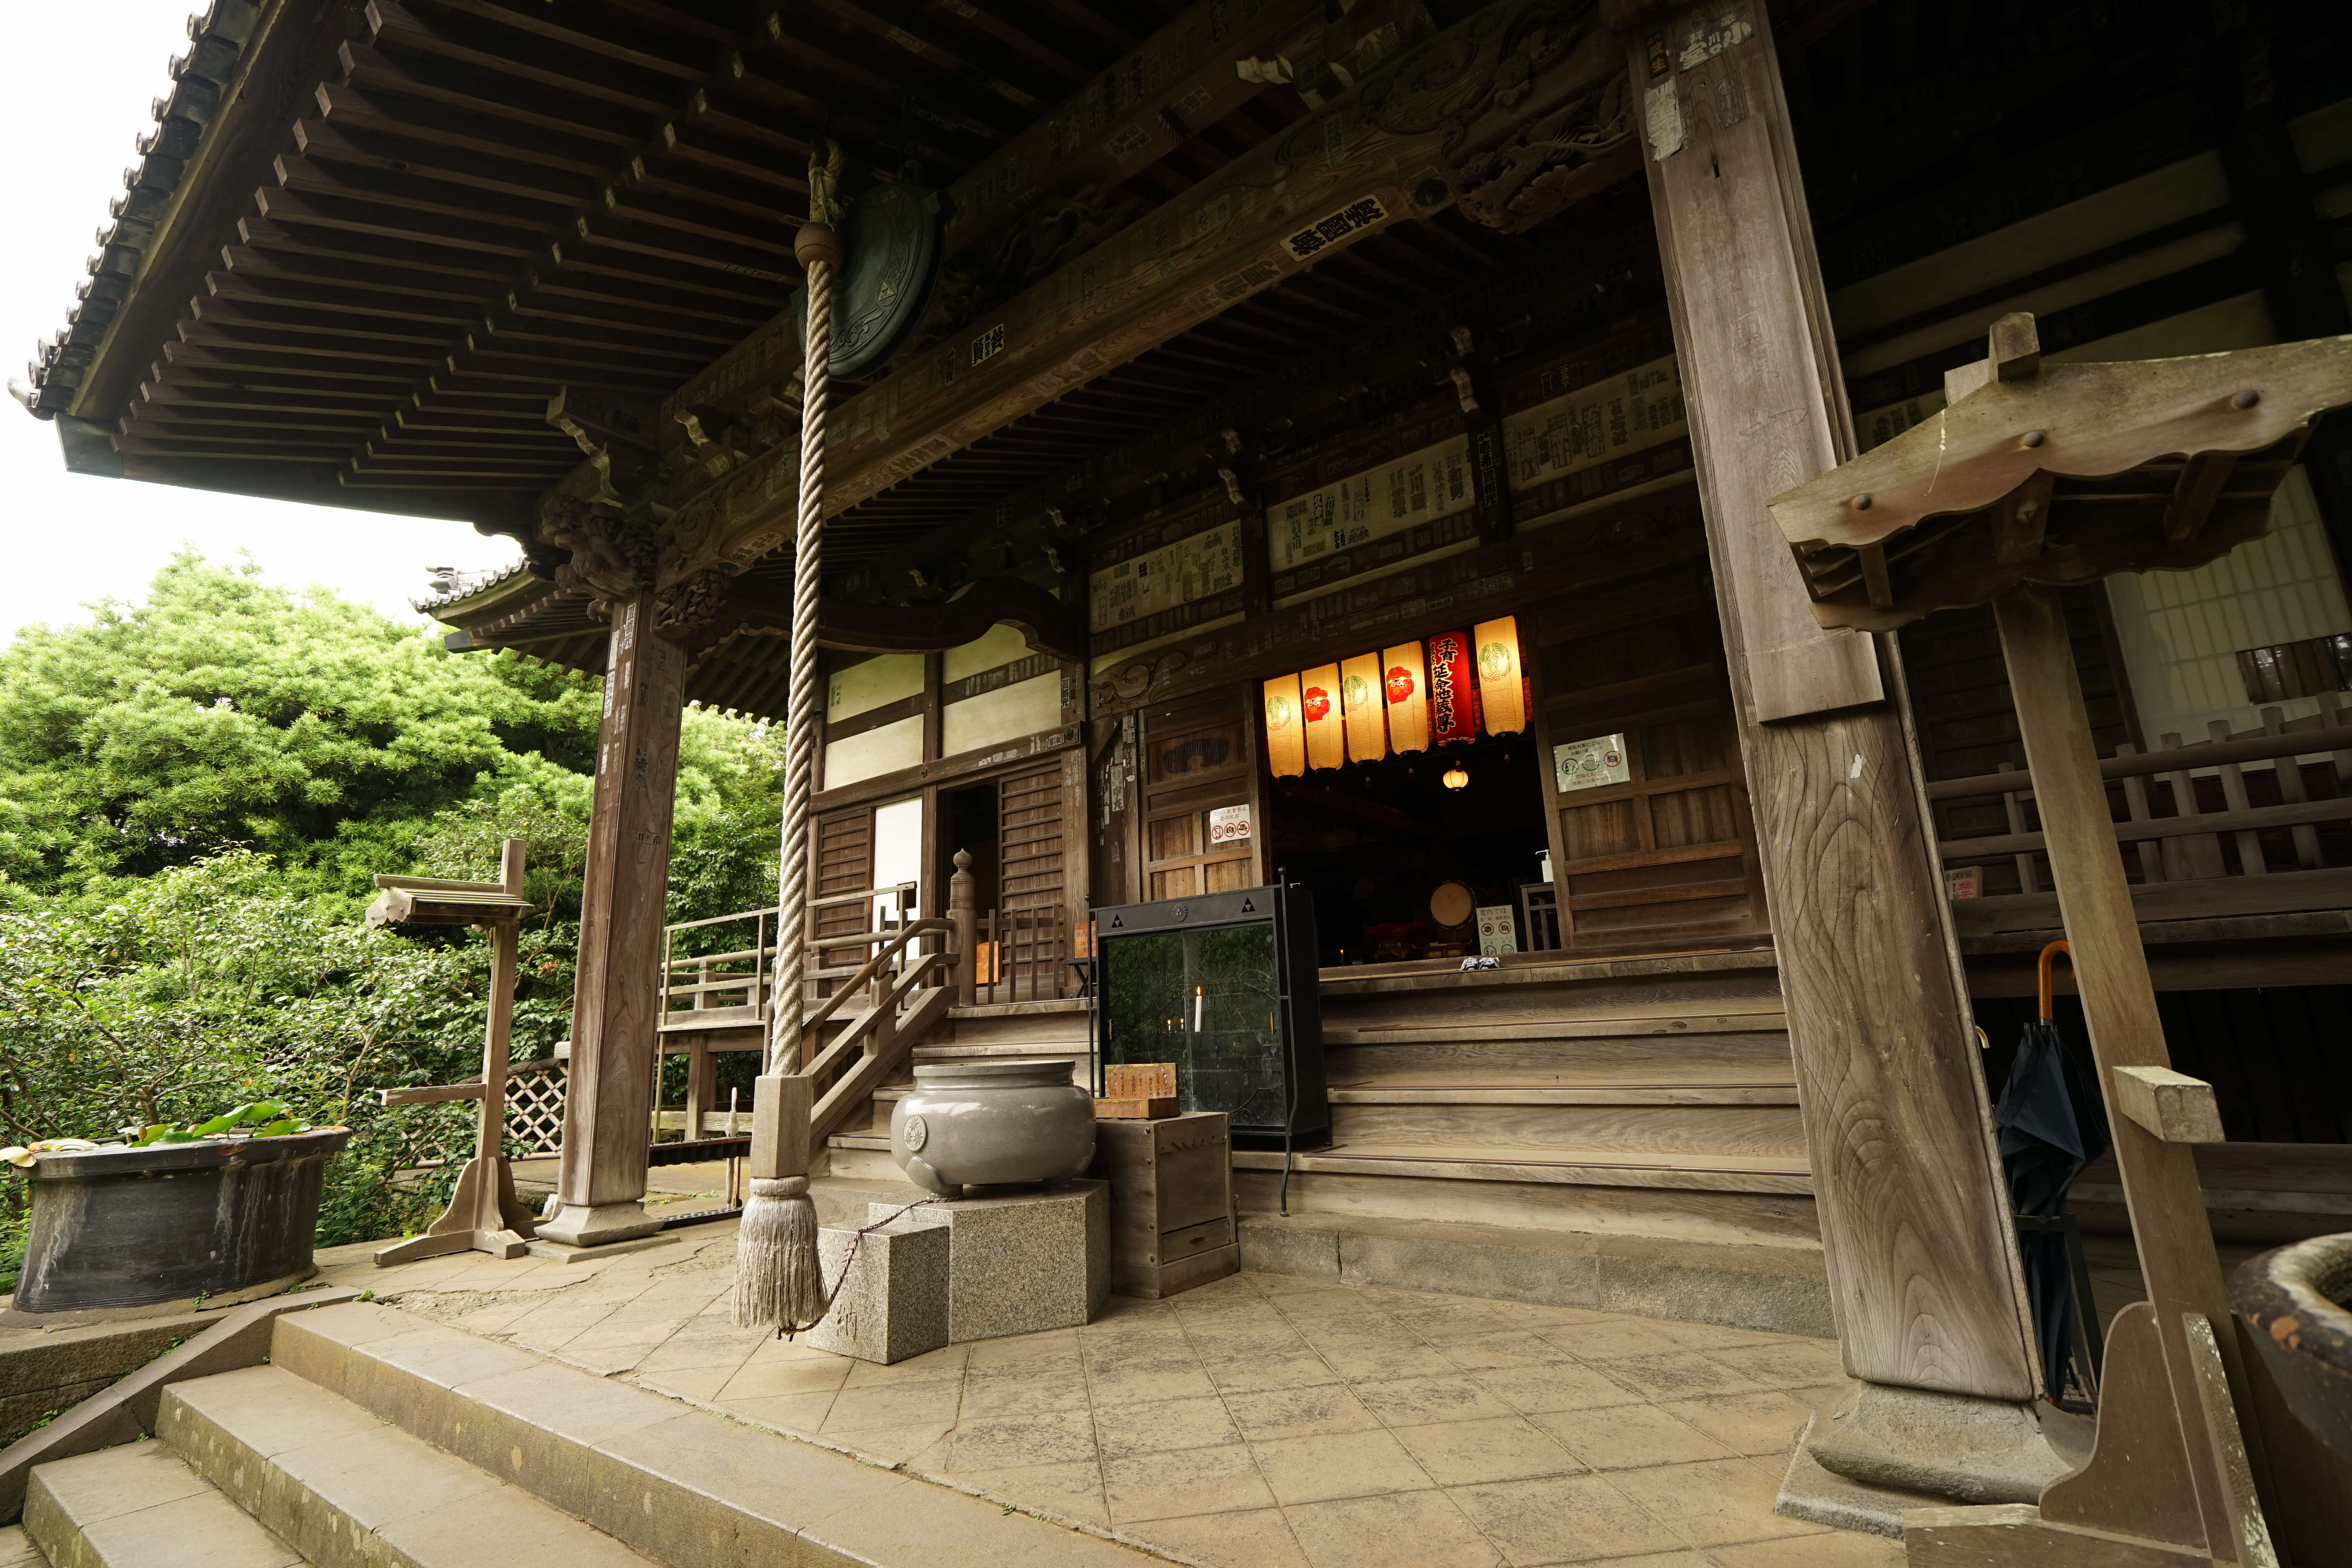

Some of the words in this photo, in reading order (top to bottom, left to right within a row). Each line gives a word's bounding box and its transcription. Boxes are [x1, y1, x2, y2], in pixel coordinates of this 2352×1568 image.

[1953, 870, 1973, 881] SMOKING
[1480, 907, 1507, 916] 堂内では
